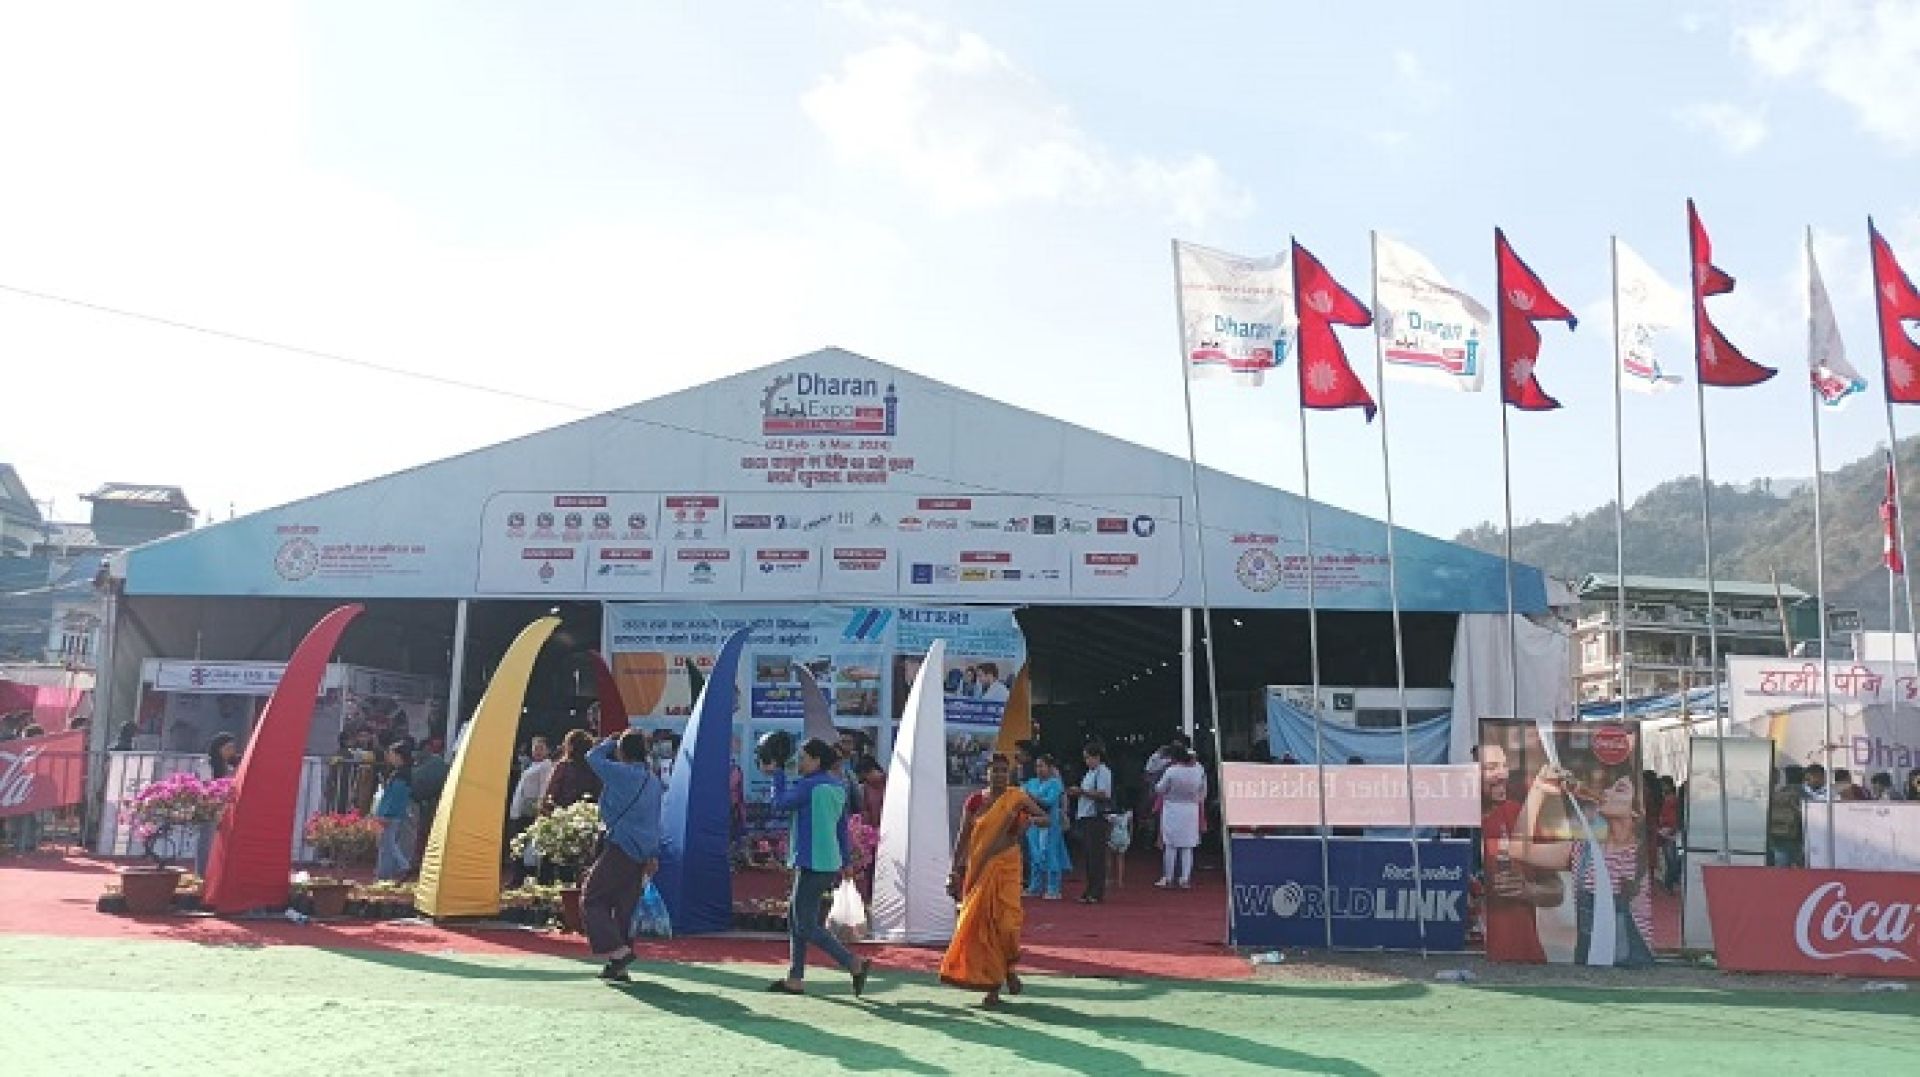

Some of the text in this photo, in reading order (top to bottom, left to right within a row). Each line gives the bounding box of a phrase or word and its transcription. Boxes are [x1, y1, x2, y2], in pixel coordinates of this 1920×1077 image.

[797, 372, 878, 396] Dharan
[808, 400, 853, 418] Expo
[899, 607, 969, 626] MITERI
[1758, 662, 1822, 699] हामी
[1833, 665, 1885, 698] पनि
[1235, 883, 1463, 922] WORLDLINK
